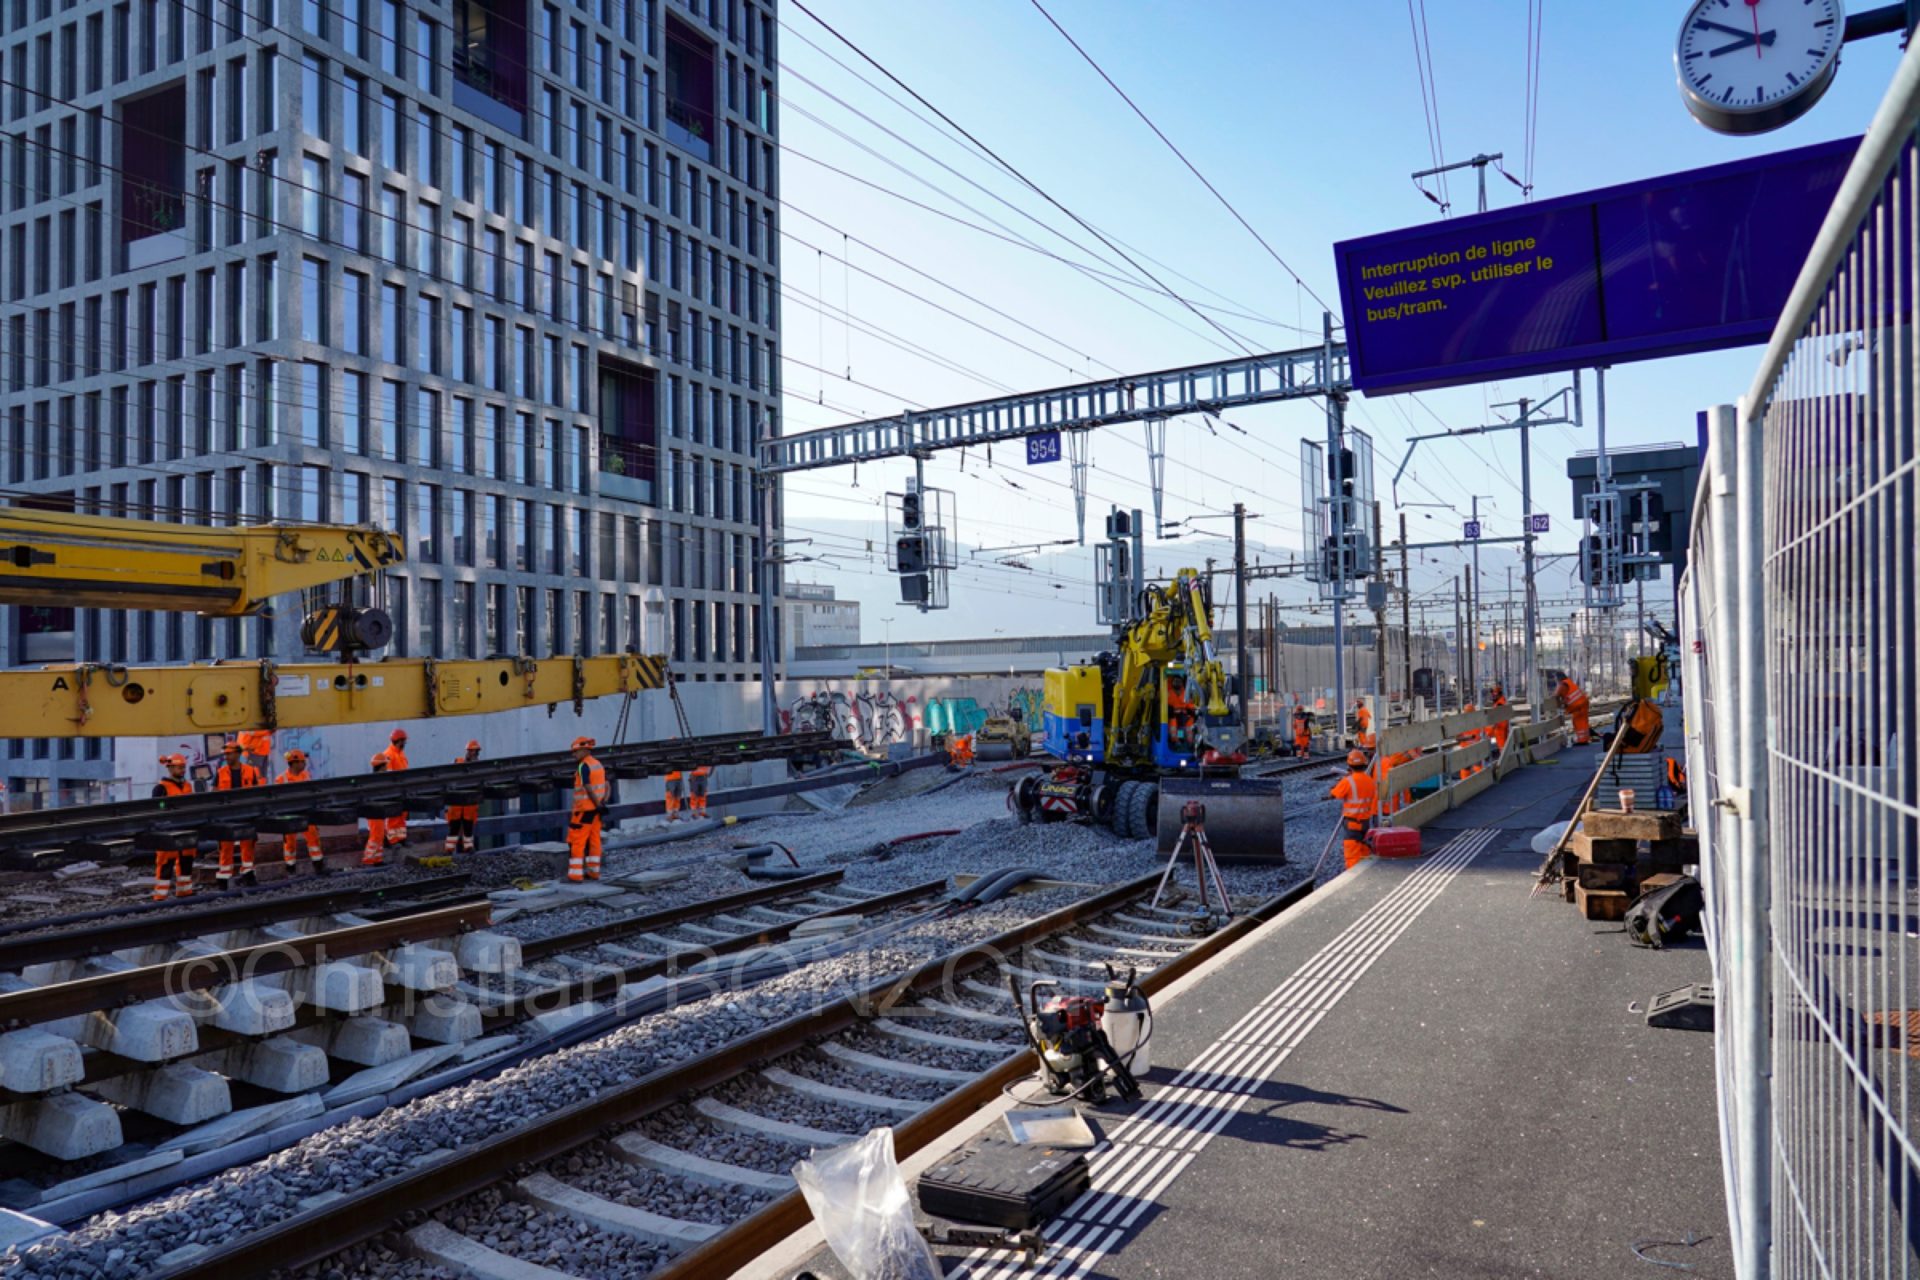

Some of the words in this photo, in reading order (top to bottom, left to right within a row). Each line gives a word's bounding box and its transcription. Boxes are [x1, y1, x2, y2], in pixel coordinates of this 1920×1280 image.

[1361, 253, 1460, 280] Interruption
[1465, 245, 1487, 261] de
[1492, 237, 1536, 256] ligne
[1364, 279, 1427, 300] Veuillez
[1431, 274, 1466, 289] svp.
[1471, 260, 1532, 282] utiliser
[1537, 256, 1553, 271] le
[1367, 299, 1448, 322] bus/tram.
[1031, 438, 1057, 460] 954
[1466, 524, 1479, 537] 63
[1534, 516, 1547, 530] 62
[52, 677, 69, 691] A
